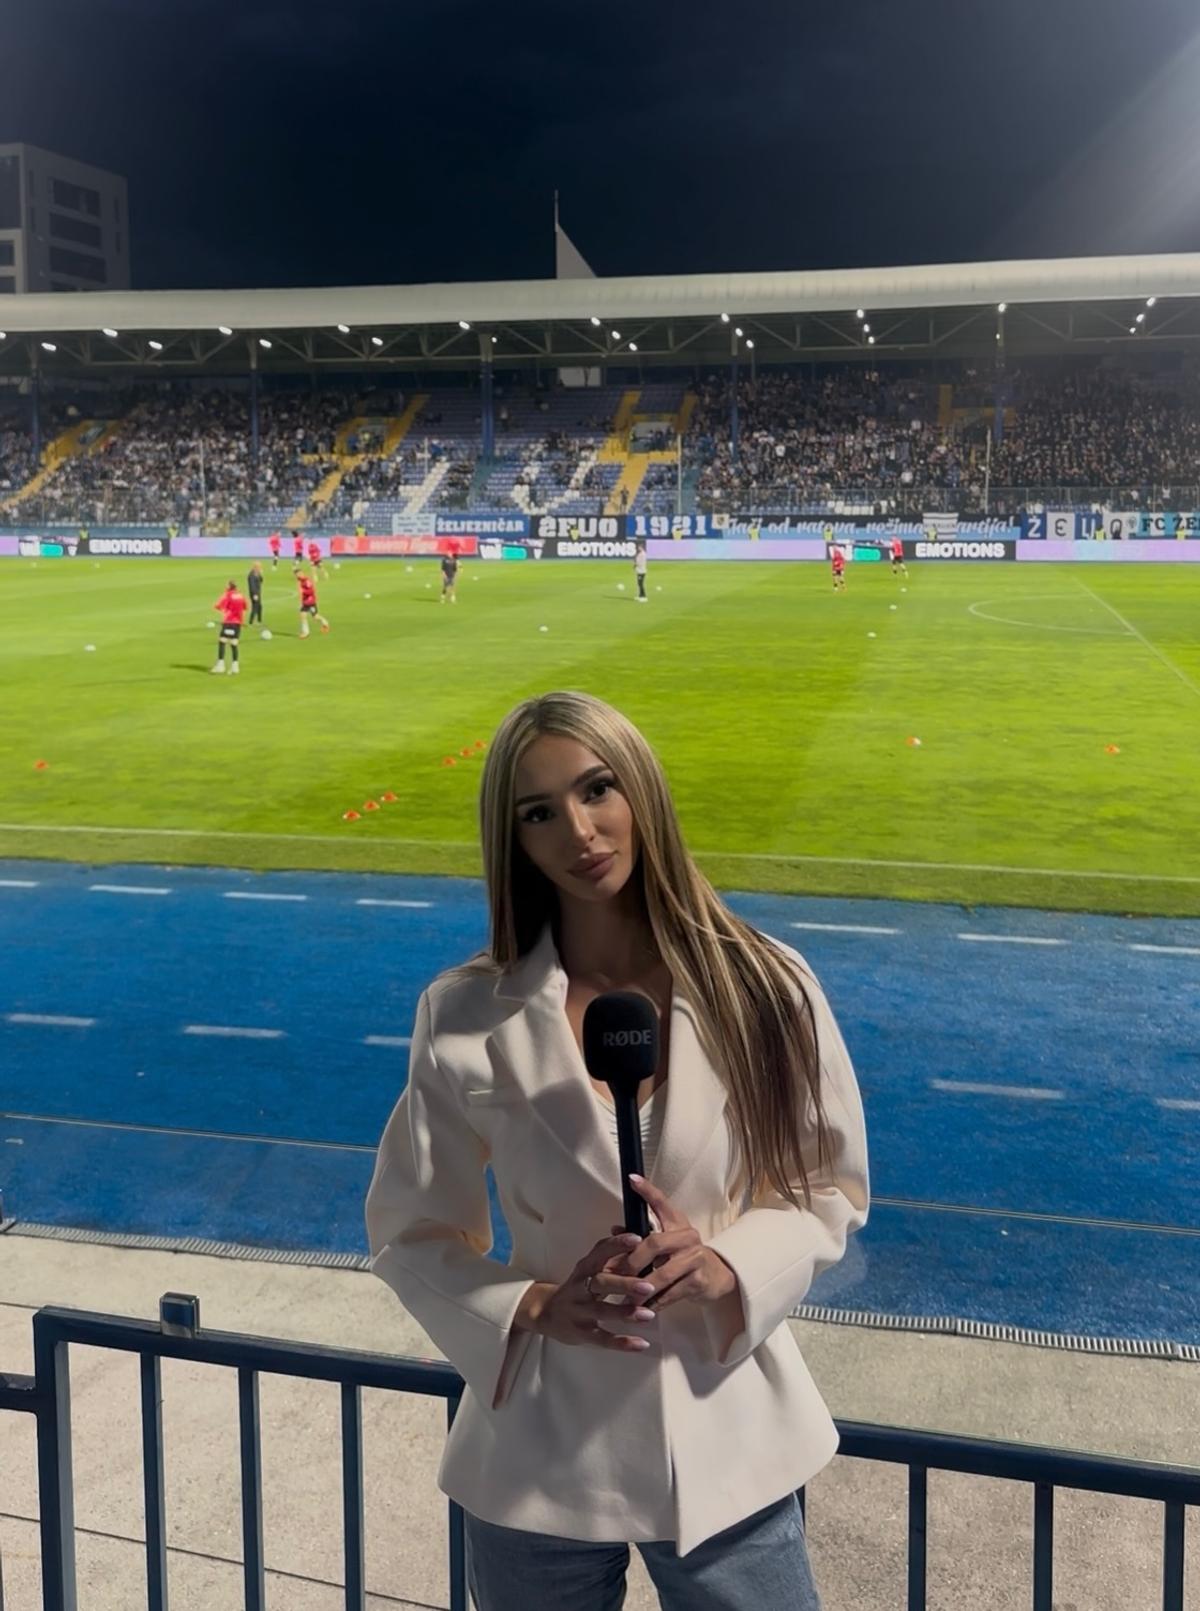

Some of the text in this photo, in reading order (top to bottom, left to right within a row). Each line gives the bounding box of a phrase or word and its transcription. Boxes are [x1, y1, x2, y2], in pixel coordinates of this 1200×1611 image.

[635, 515, 707, 536] 1921
[768, 516, 791, 533] od
[1142, 517, 1166, 532] FC
[88, 538, 163, 554] EMOTIONS
[556, 541, 636, 557] EMOTIONS
[915, 542, 1006, 558] EMOTIONS
[603, 1029, 652, 1046] RØDE
